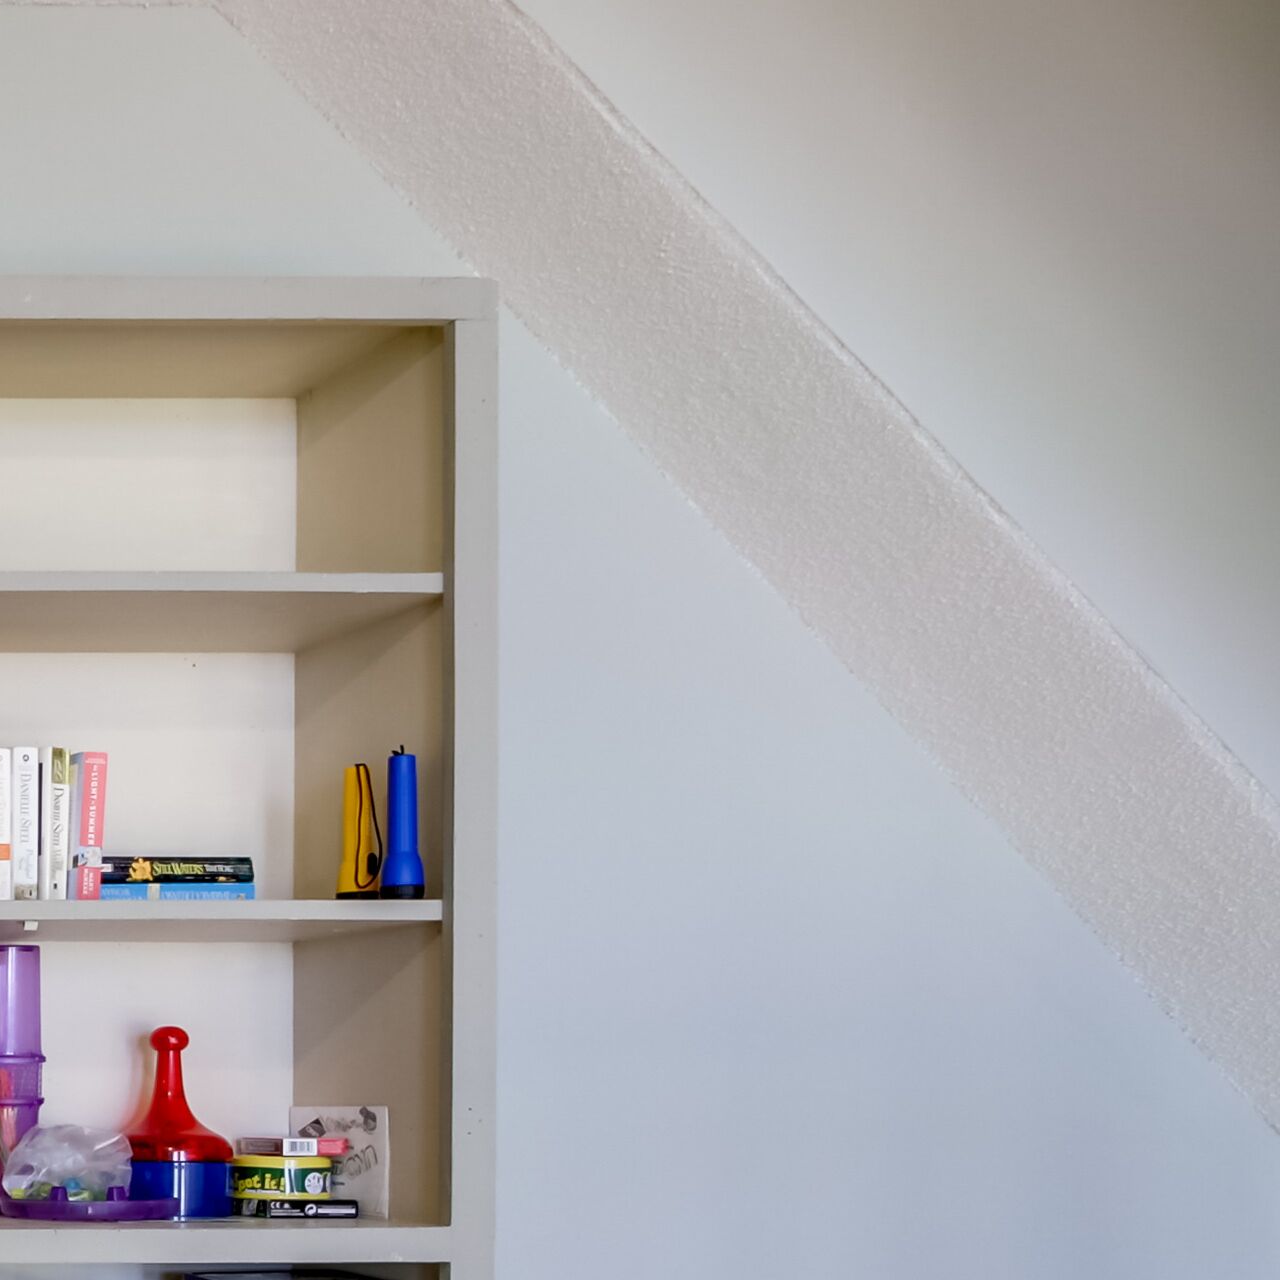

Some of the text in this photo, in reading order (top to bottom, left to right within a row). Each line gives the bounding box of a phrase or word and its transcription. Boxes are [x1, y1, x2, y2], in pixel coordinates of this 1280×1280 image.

[90, 772, 98, 800] LIGHT
[20, 774, 32, 844] DANIELLE STEEL
[53, 787, 64, 821] DANIELLE
[52, 823, 65, 846] STEEL
[88, 805, 96, 845] SUMMER
[172, 863, 204, 875] WATERS
